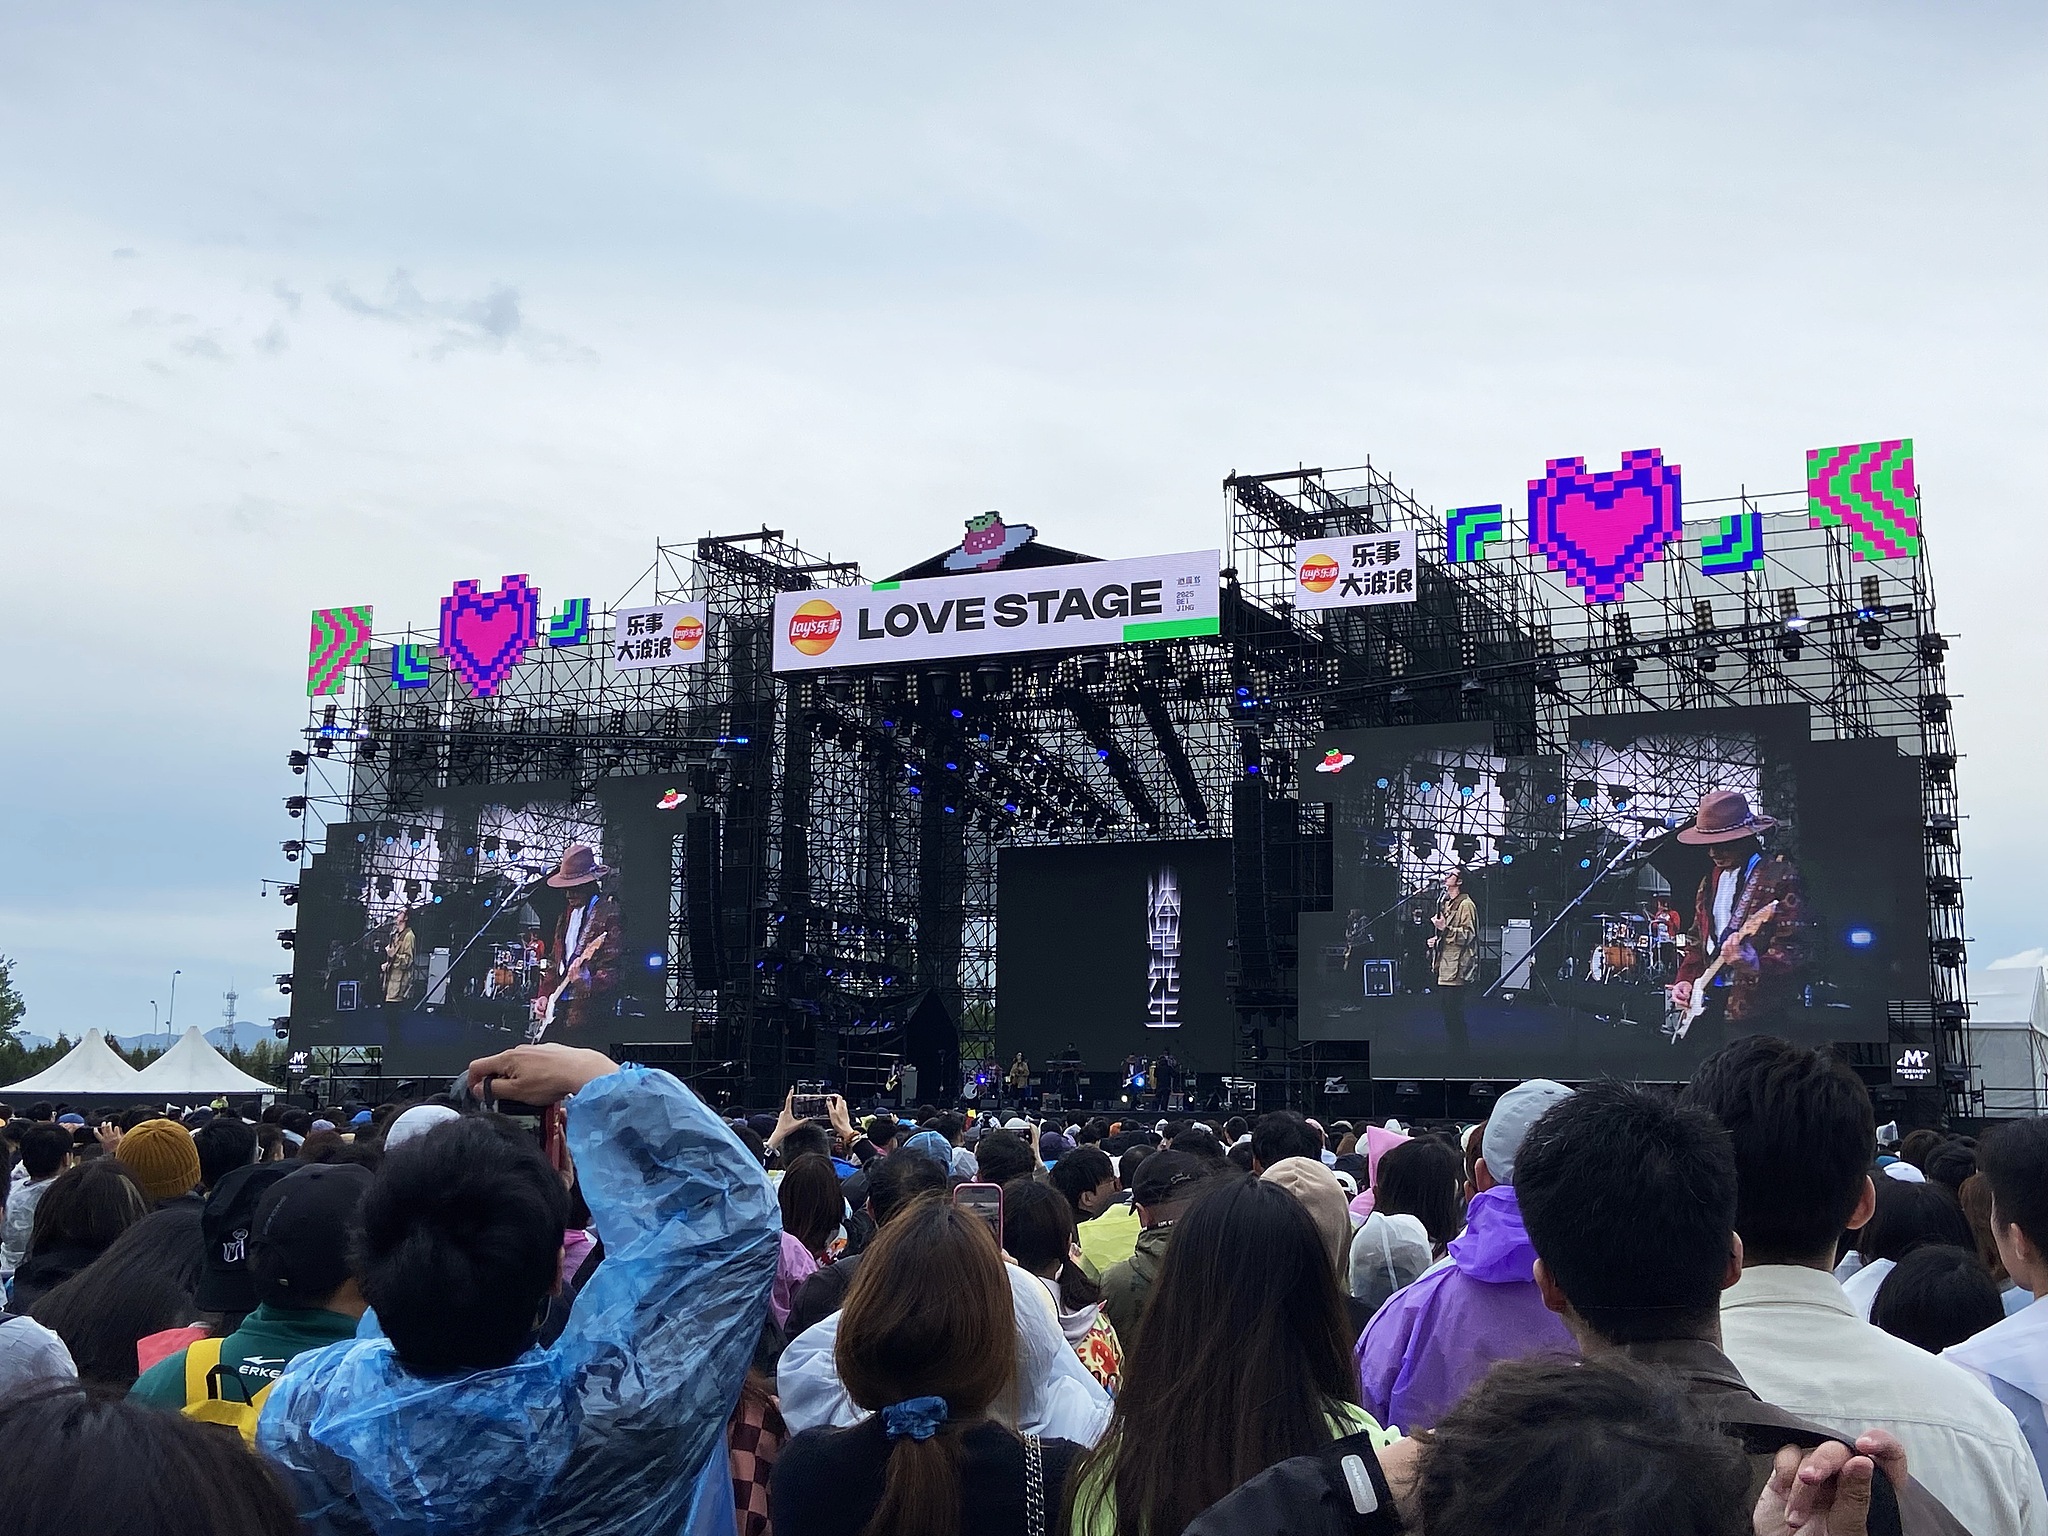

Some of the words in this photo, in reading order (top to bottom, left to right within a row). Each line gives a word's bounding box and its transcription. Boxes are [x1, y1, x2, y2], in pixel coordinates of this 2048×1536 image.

[1351, 540, 1401, 568] 乐事
[1176, 591, 1195, 599] 2025
[1340, 568, 1413, 598] 大波浪
[859, 597, 985, 641] LOVE
[993, 580, 1162, 628] STAGE
[627, 612, 664, 636] 乐事
[617, 636, 672, 662] 大波浪
[239, 1365, 282, 1379] ERKE
